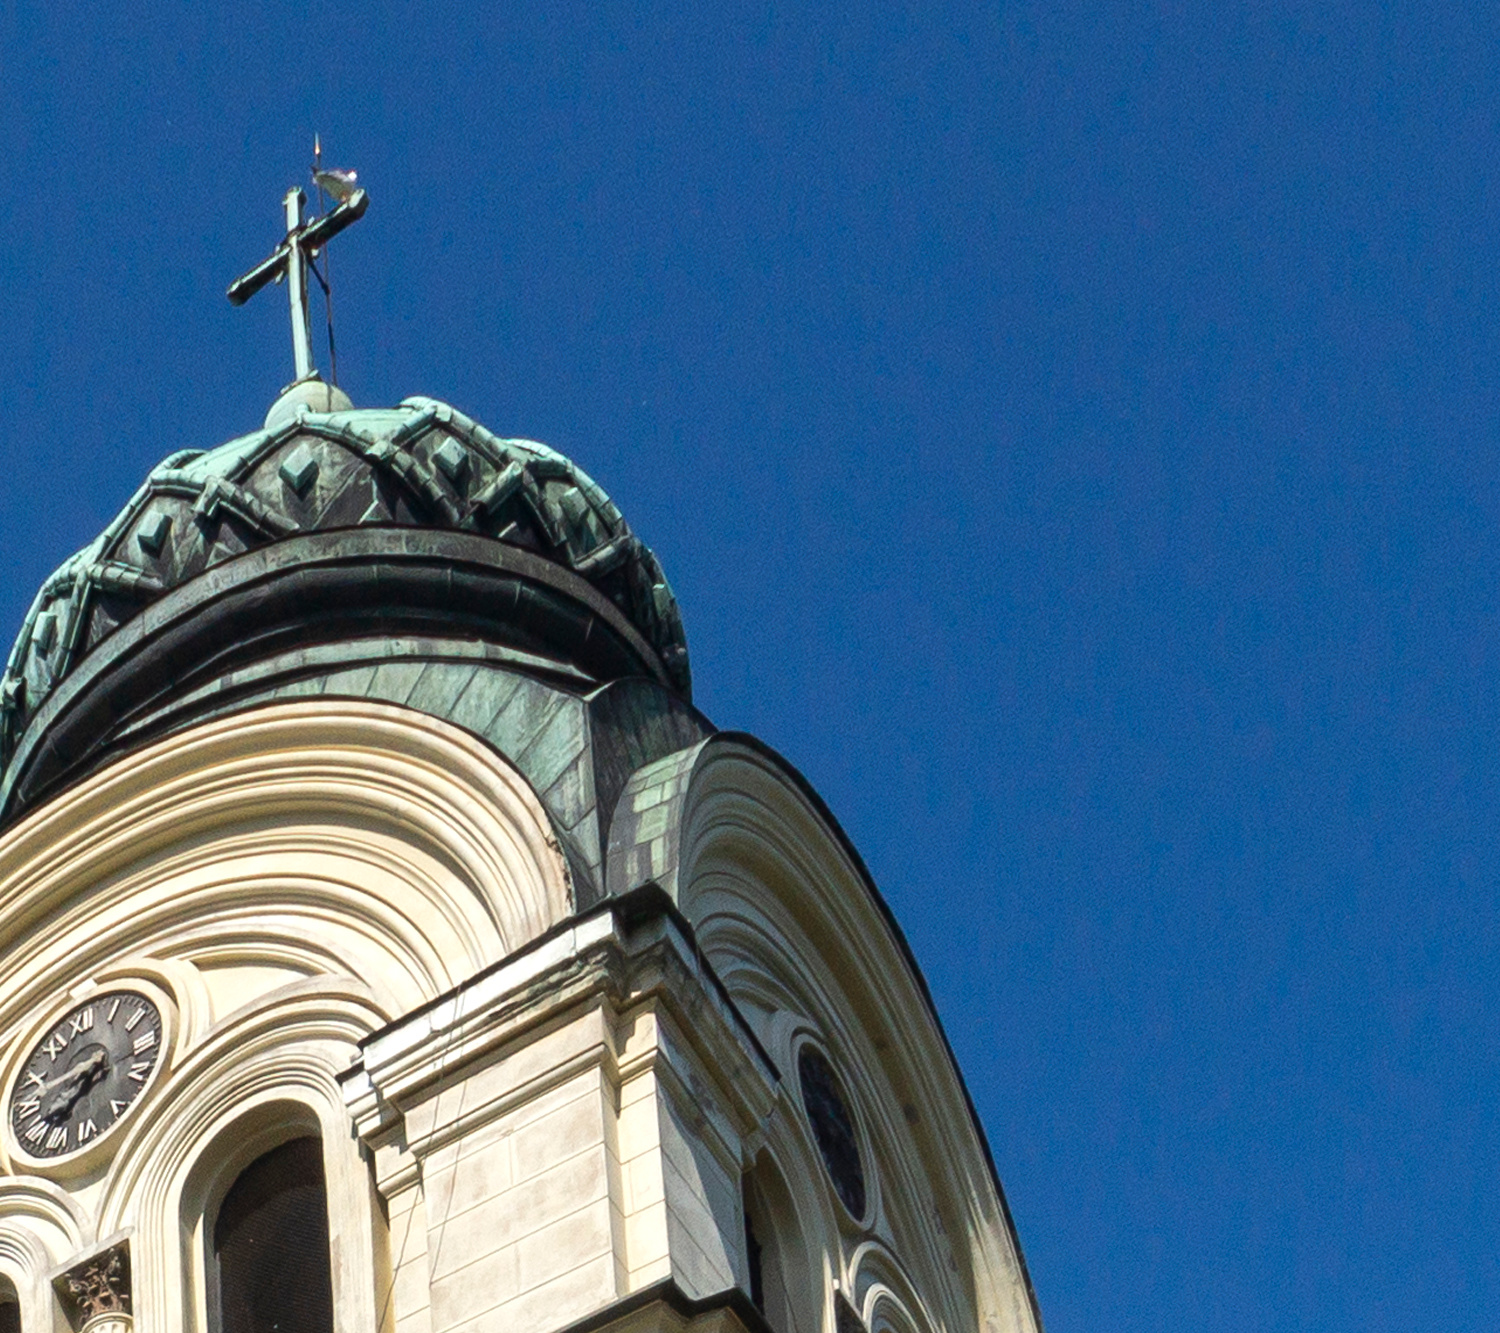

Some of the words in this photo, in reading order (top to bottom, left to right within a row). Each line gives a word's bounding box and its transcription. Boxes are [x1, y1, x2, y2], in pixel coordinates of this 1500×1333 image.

[107, 999, 120, 1022] I
[125, 1008, 146, 1031] II
[69, 1007, 93, 1040] XII
[43, 1033, 68, 1061] XI
[133, 1030, 155, 1056] III
[19, 1070, 48, 1092] X
[127, 1061, 150, 1081] IV
[19, 1095, 40, 1119] IX
[111, 1099, 126, 1115] V
[78, 1118, 97, 1142] VI
